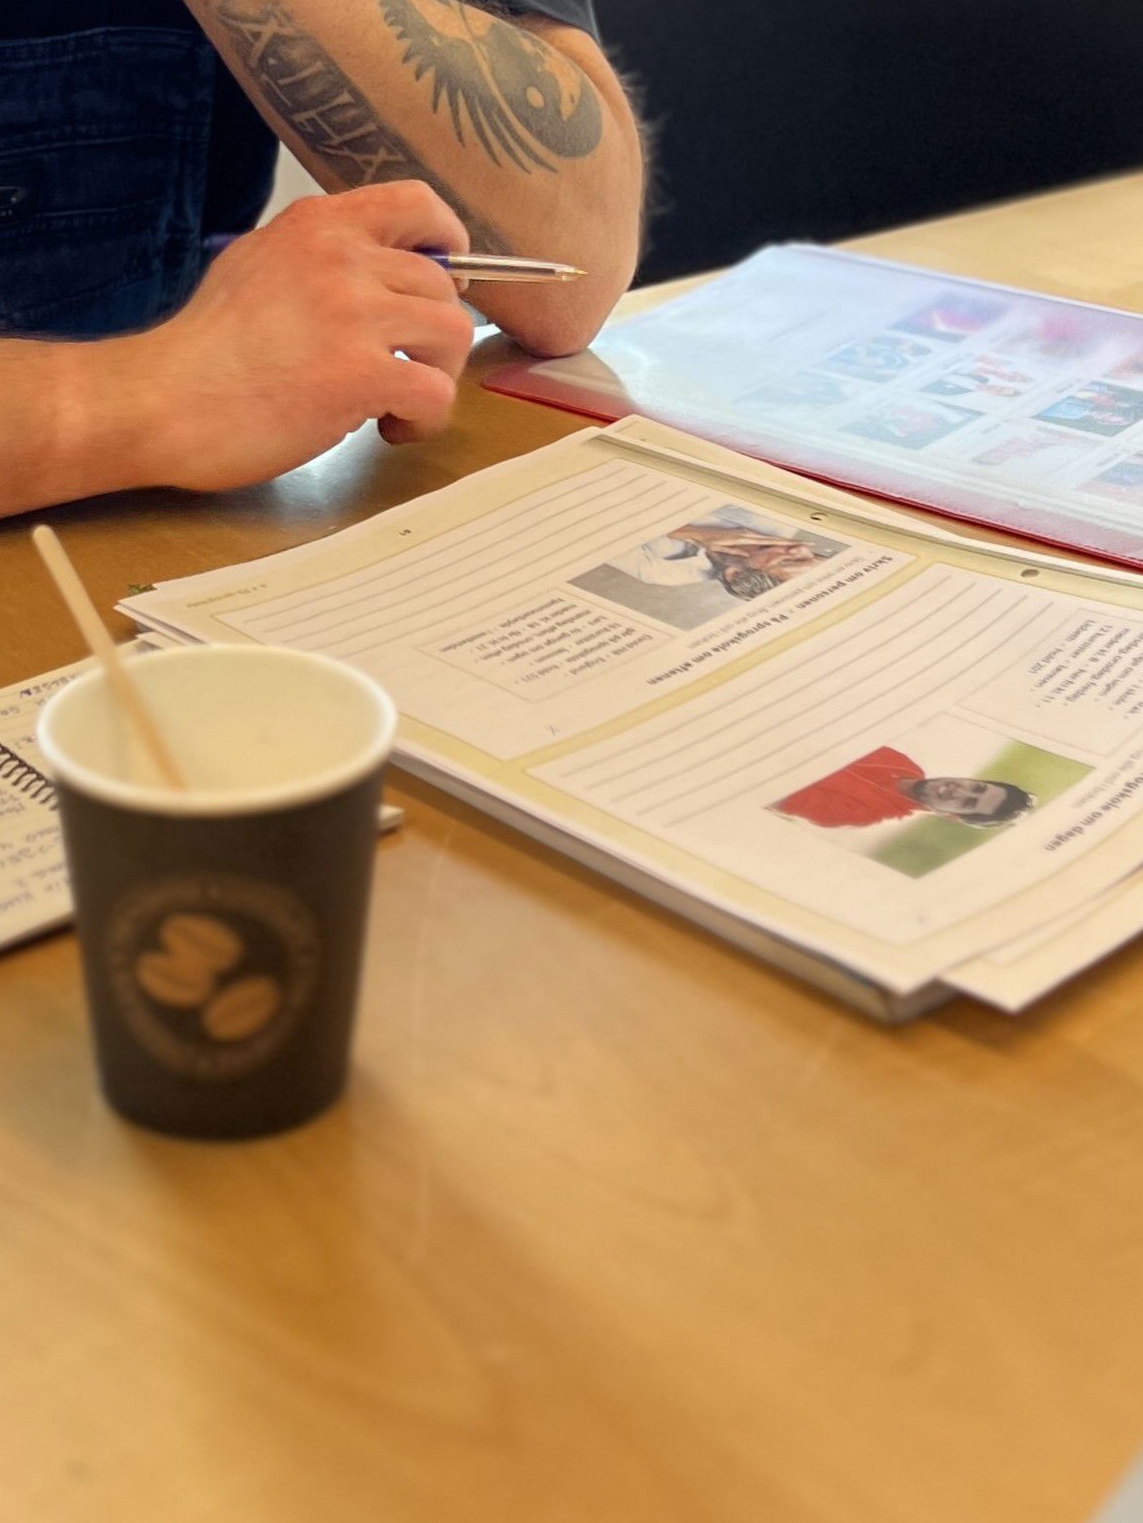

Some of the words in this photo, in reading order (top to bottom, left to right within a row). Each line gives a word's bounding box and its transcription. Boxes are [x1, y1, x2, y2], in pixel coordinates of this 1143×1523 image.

[844, 571, 864, 583] om
[794, 580, 847, 610] personen
[711, 622, 772, 652] sprogskole
[691, 651, 713, 663] om
